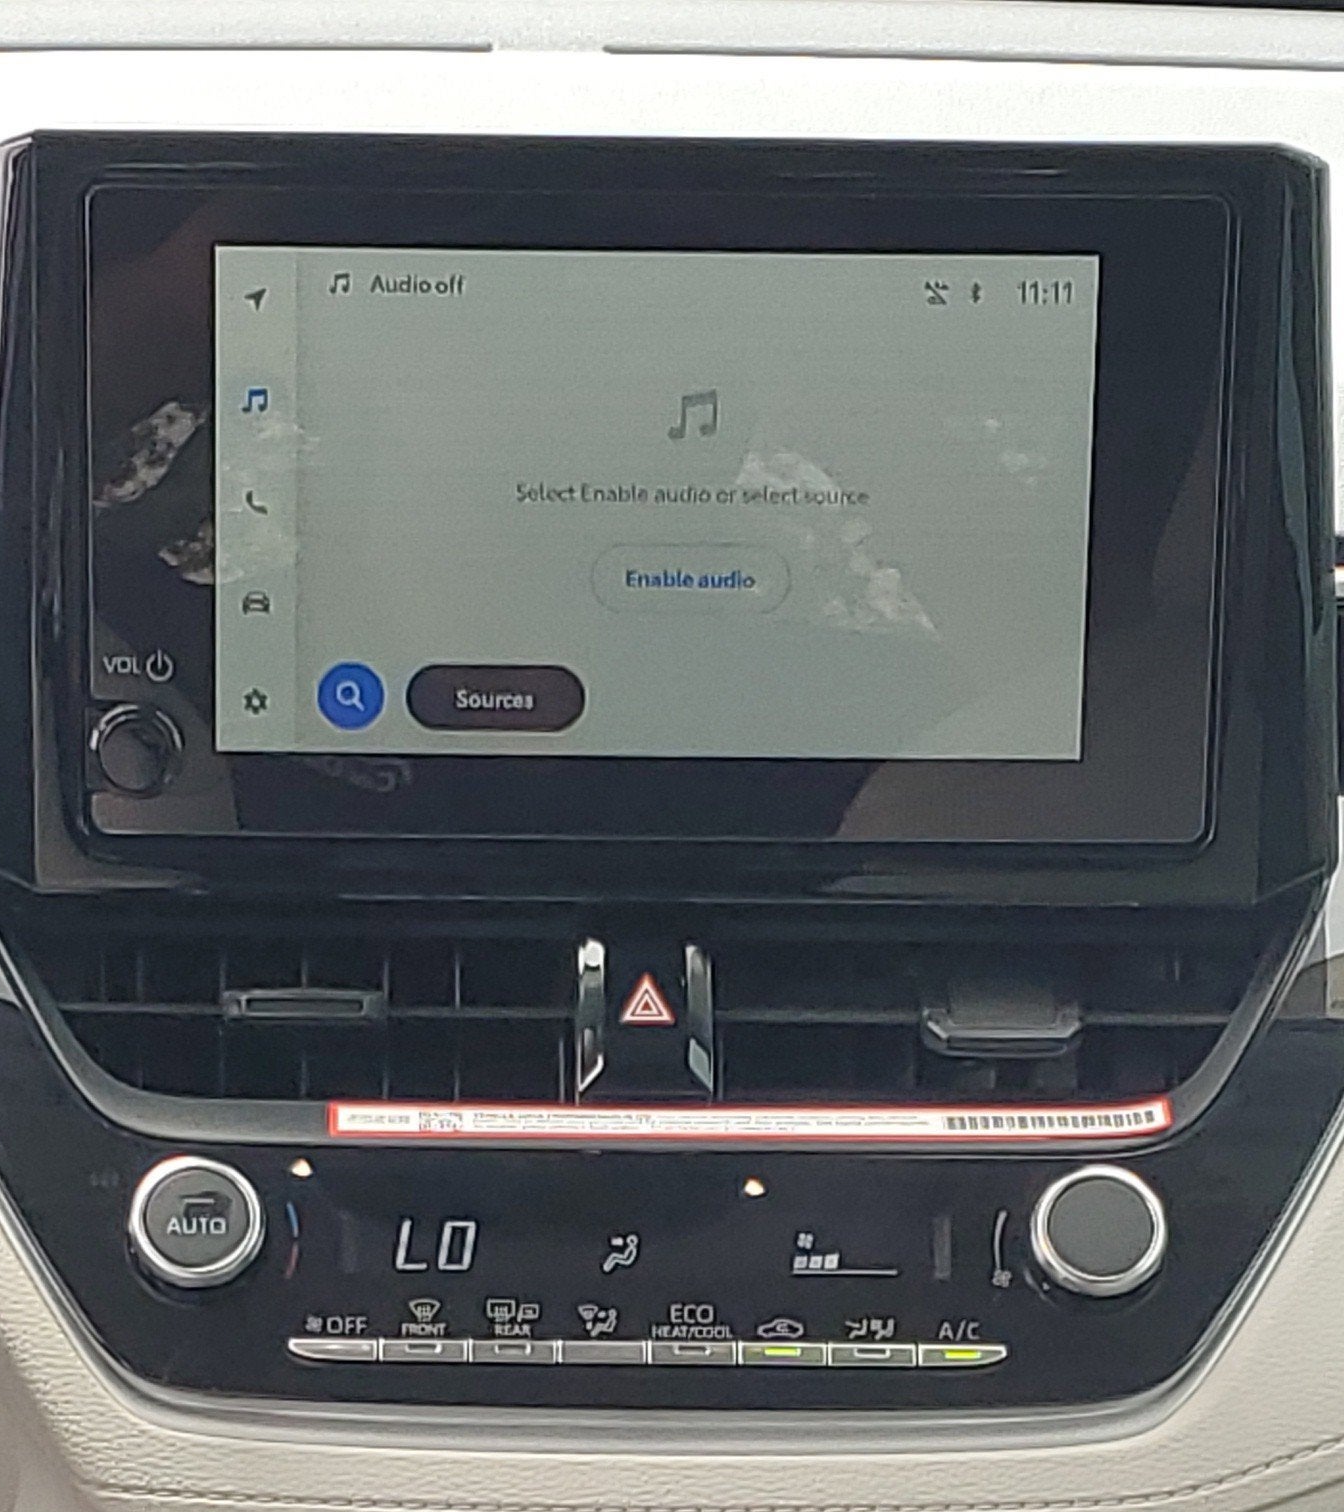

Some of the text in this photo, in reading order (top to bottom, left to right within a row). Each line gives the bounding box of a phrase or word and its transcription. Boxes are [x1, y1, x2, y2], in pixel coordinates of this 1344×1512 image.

[369, 273, 465, 295] Audio off
[1017, 280, 1073, 306] 11:11
[515, 483, 869, 507] Select Enable audio or select source
[626, 568, 756, 590] Enable audio
[102, 655, 140, 676] VOL
[456, 689, 535, 711] Sources
[166, 1216, 227, 1236] AUTO
[669, 1303, 714, 1325] ECO
[326, 1315, 368, 1335] OFF
[401, 1322, 446, 1338] FRONT
[494, 1322, 532, 1338] REAR
[651, 1325, 733, 1340] HEAT/COOL
[939, 1321, 981, 1341] A/C
